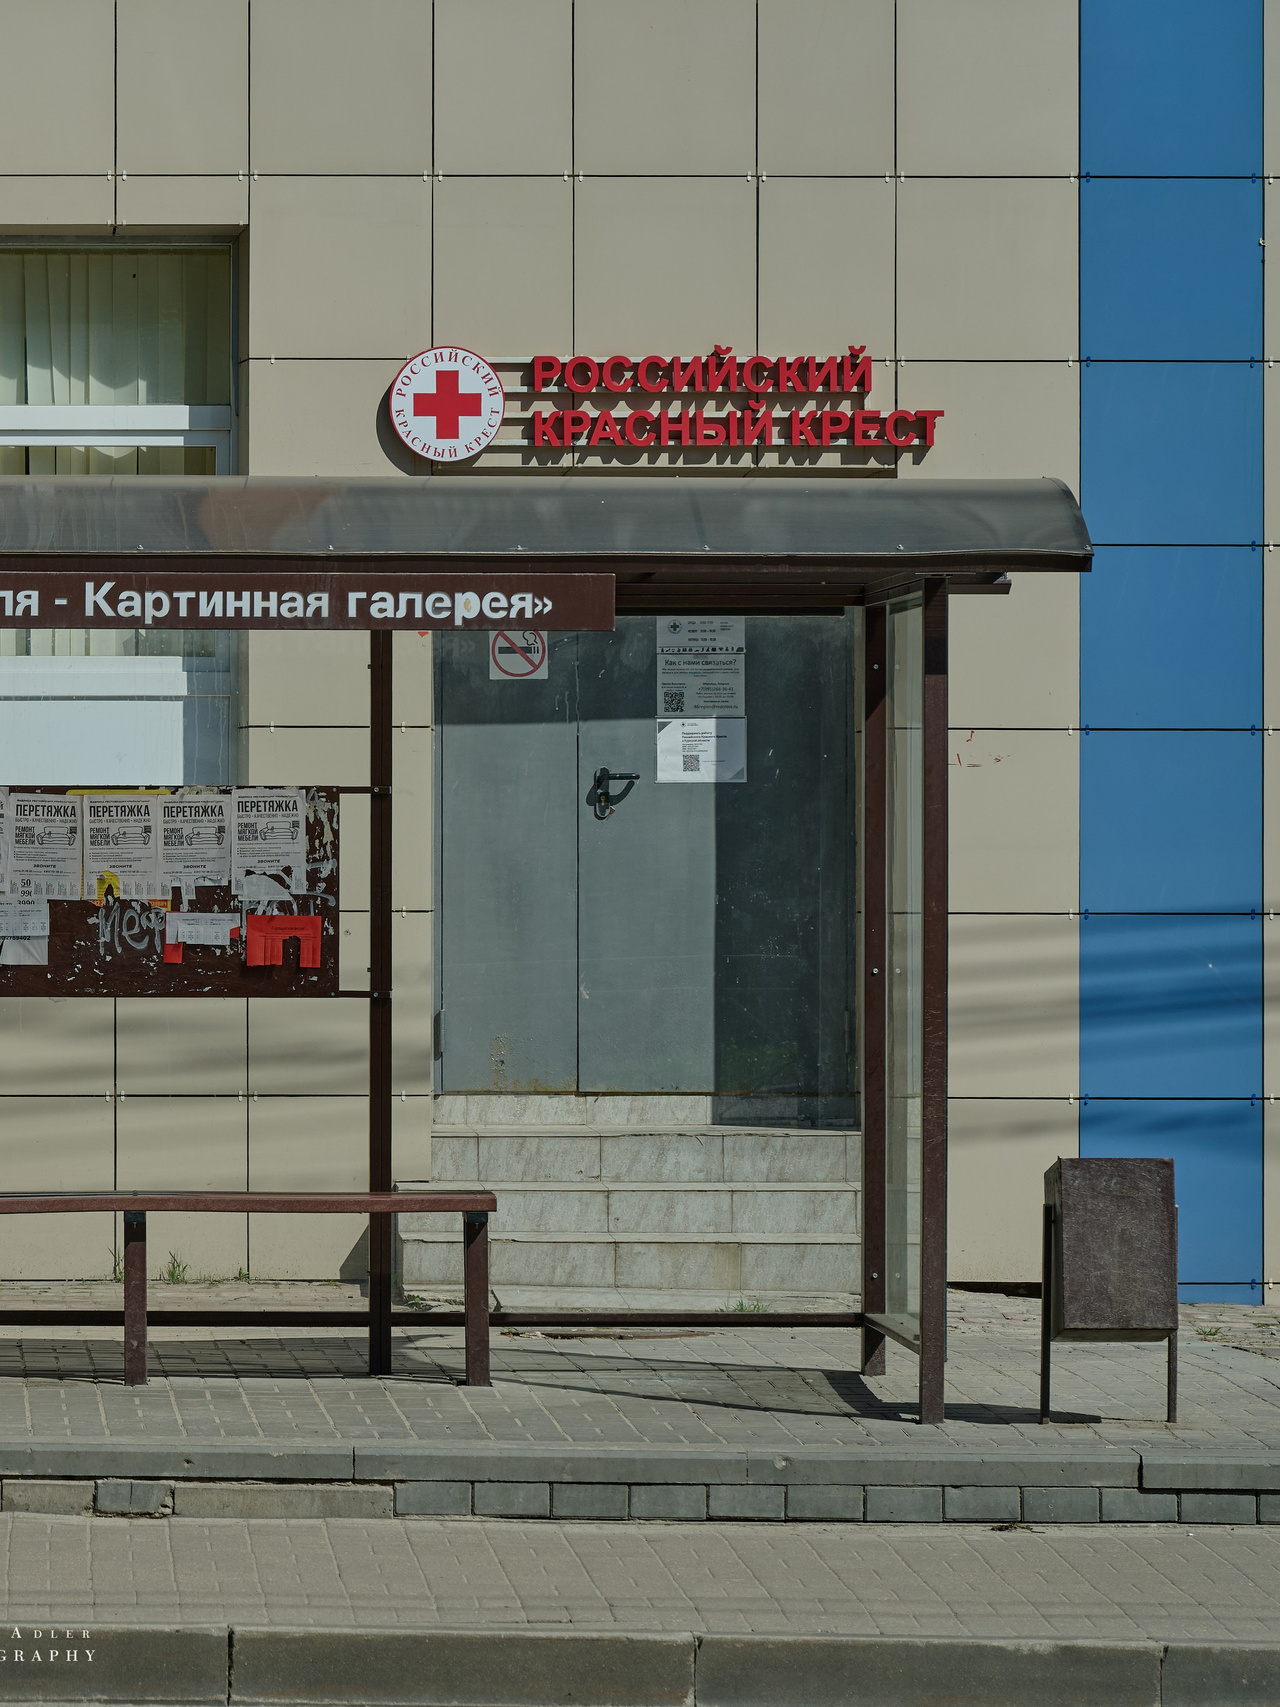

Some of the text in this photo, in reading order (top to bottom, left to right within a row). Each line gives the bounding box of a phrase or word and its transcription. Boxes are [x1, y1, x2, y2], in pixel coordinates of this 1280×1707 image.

[395, 348, 502, 398] РОССИЙСКИЙ
[533, 344, 872, 393] РОССИЙСКИЙ
[533, 400, 946, 447] КРАСНЫЙ КРЕСТ
[394, 406, 501, 459] КРАСНЫЙ КРЕСТ
[84, 580, 329, 625] Картинная
[348, 591, 554, 626] галерея»
[15, 804, 77, 818] ПЕРЕТЯЖКА
[89, 805, 151, 818] ПЕРЕТЯЖКА
[163, 805, 224, 818] ПЕРЕТЯЖКА
[237, 799, 298, 813] ПЕРЕТЯЖКА
[90, 826, 110, 834] РЕМОНТ
[20, 878, 31, 888] 50
